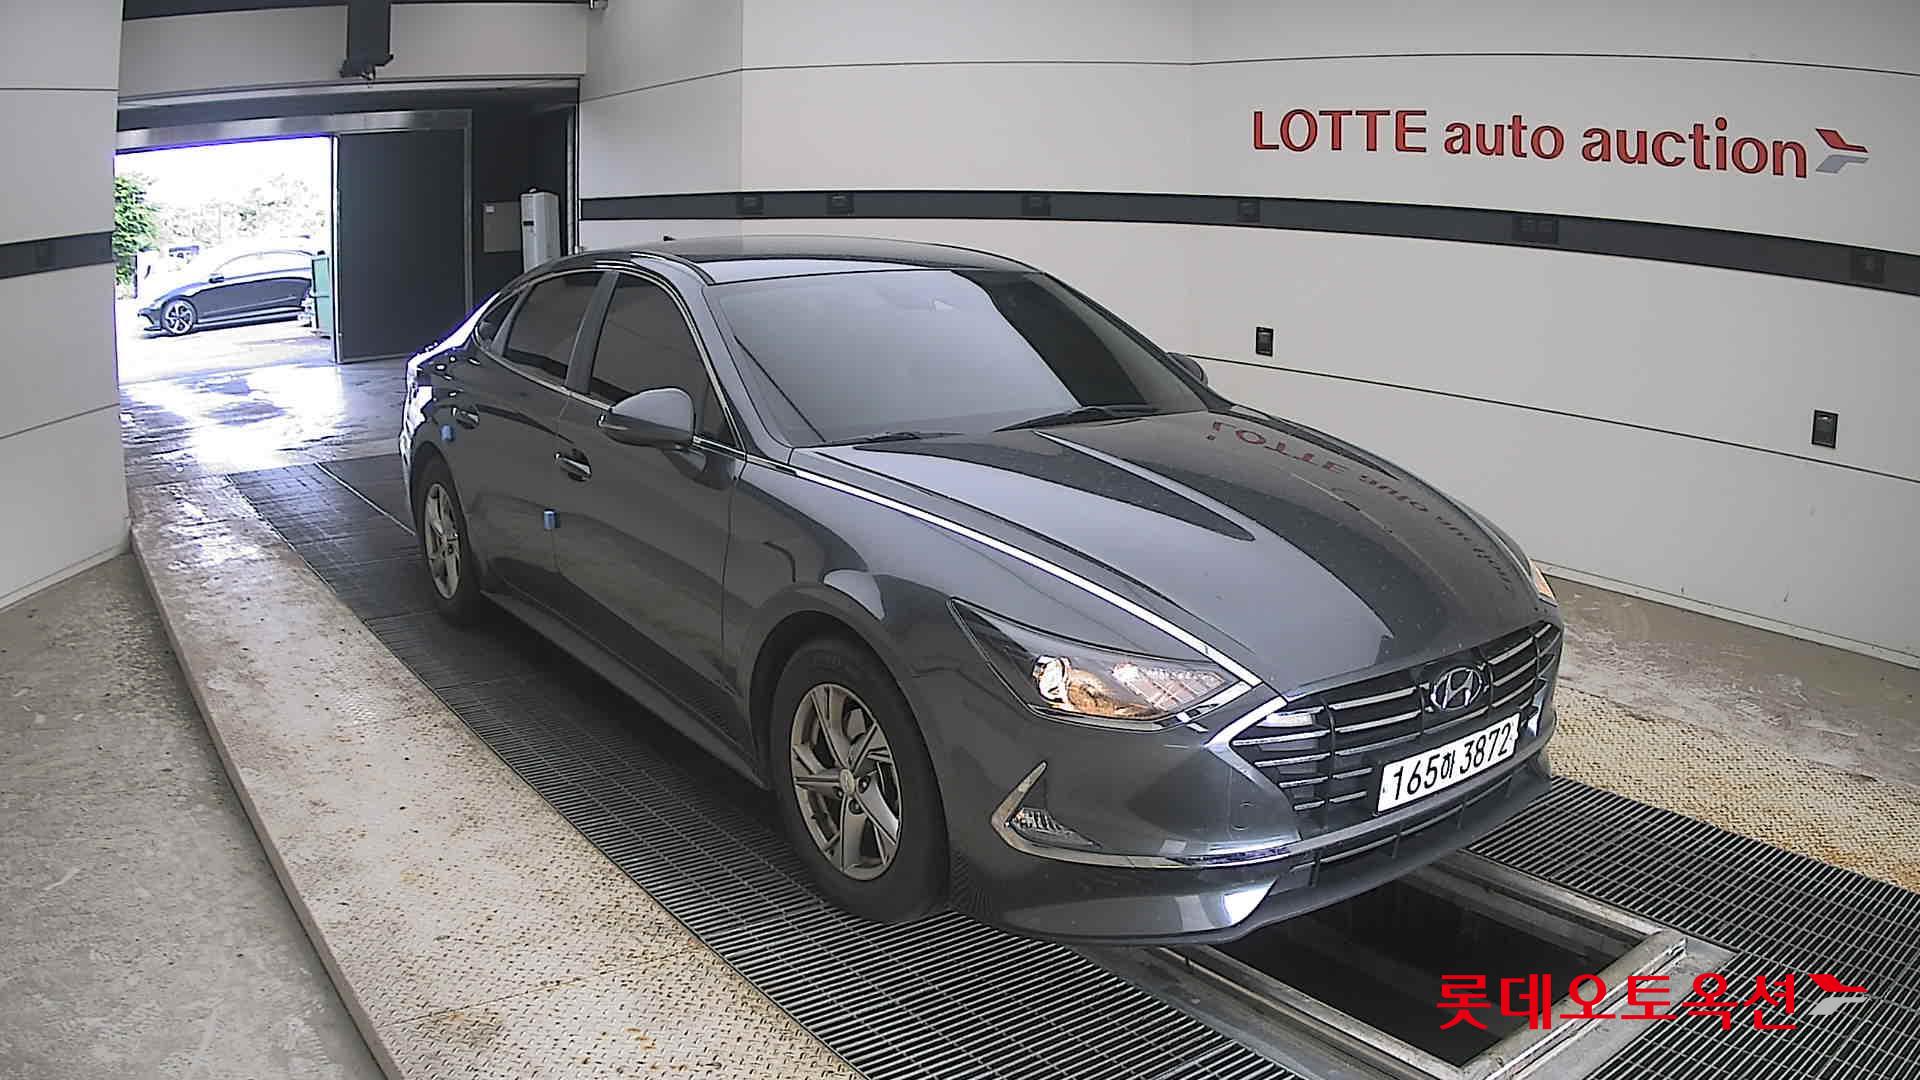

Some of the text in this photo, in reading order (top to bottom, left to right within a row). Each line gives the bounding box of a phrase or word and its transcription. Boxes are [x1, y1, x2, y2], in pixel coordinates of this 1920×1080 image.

[1253, 110, 1808, 179] LOTTE auto auction
[1393, 723, 1511, 800] 165하 3872
